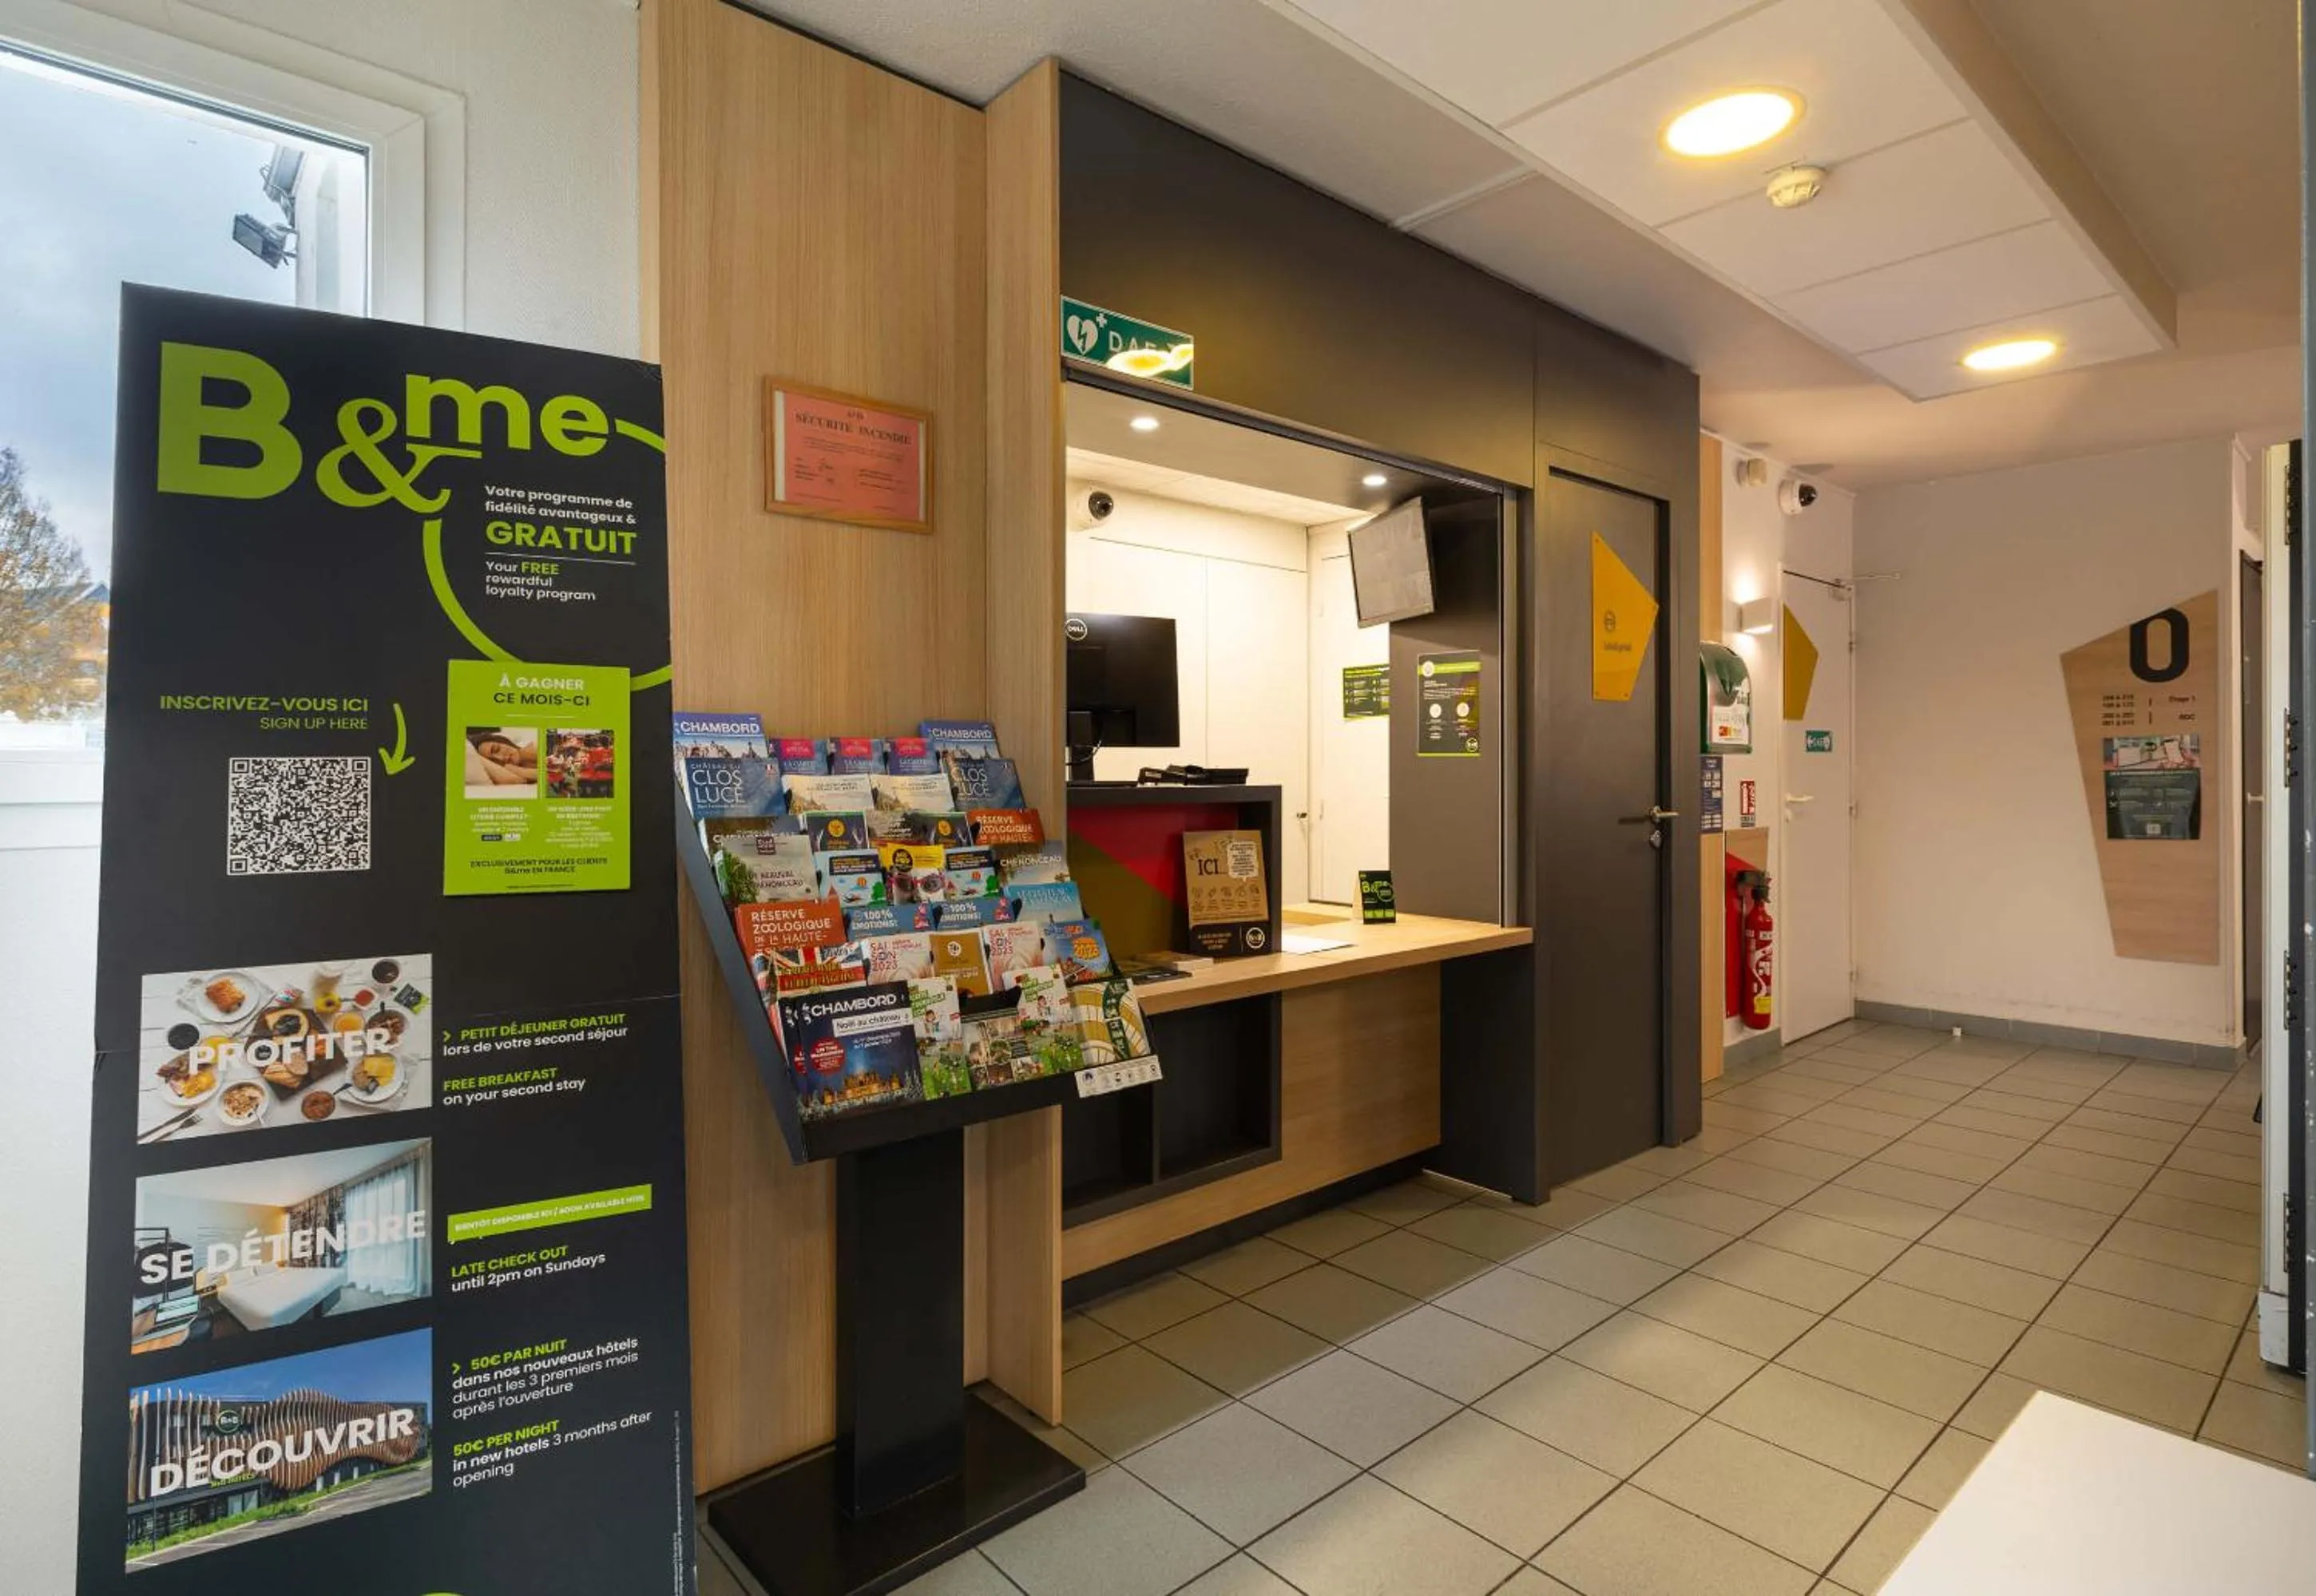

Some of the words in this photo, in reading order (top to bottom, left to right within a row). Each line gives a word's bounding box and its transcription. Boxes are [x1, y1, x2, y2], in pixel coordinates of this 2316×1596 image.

[859, 426, 912, 445] INCENDIE
[486, 485, 525, 498] Votre
[528, 490, 613, 505] programme
[615, 498, 633, 509] de
[486, 501, 536, 515] fidélité
[538, 506, 623, 525] avantageux
[626, 514, 637, 525] &
[486, 521, 637, 554] GRATUIT
[486, 561, 518, 572] Your
[521, 561, 560, 575] FREE
[486, 574, 553, 587] rewardful
[486, 584, 533, 599] loyalty
[537, 590, 596, 602] program
[499, 673, 511, 687] À
[515, 677, 585, 691] GAGNER
[160, 695, 338, 711] INSCRIVEZ-VOUS
[343, 698, 369, 712] ICI
[494, 692, 516, 704] CE
[520, 693, 590, 707] MOIS-CI
[260, 717, 299, 730] SIGN
[304, 718, 326, 730] UP
[330, 719, 368, 730] HERE
[680, 721, 761, 734] CHAMBORD
[932, 728, 992, 739] CHAMBORD
[692, 770, 742, 786] CLOS
[470, 859, 537, 869] EXCLUSIVEMENT
[752, 908, 805, 921] RÉSERVE
[753, 918, 831, 935] ZOOLOGIQUE
[990, 947, 1013, 956] 2023
[871, 961, 898, 972] 2023
[811, 994, 897, 1016] CHAMBORD
[461, 1027, 497, 1040] PETIT
[500, 1020, 568, 1036] DÉJEUNER
[569, 1013, 626, 1028] GRATUIT
[188, 1028, 391, 1075] PROFITER
[443, 1044, 470, 1056] lors
[474, 1041, 492, 1053] de
[495, 1037, 531, 1050] votre
[535, 1030, 585, 1046] second
[588, 1027, 629, 1042] séjour
[443, 1078, 476, 1091] FREE
[479, 1067, 558, 1088] BREAKFAST
[443, 1094, 462, 1106] on
[466, 1090, 499, 1106] your
[502, 1081, 553, 1099] second
[557, 1078, 586, 1092] stay
[141, 1248, 196, 1285] SE
[206, 1209, 426, 1273] DÉTENDRE
[451, 1261, 486, 1278] LATE
[487, 1253, 536, 1272] CHECK
[540, 1245, 569, 1261] OUT
[451, 1275, 485, 1293] until
[487, 1269, 521, 1289] 2pm
[524, 1266, 542, 1278] on
[545, 1253, 606, 1274] Sundays
[452, 1372, 491, 1390] dans
[494, 1364, 521, 1381] nos
[523, 1348, 594, 1372] nouveaux
[596, 1337, 639, 1356] hôtels
[471, 1354, 502, 1371] 50€
[503, 1347, 532, 1364] PAR
[534, 1339, 568, 1356] NUIT
[452, 1383, 502, 1405] durant
[506, 1377, 525, 1392] les
[529, 1374, 539, 1386] 3
[541, 1358, 603, 1387] premiers
[605, 1351, 639, 1368] mois
[452, 1399, 495, 1421] après
[498, 1382, 574, 1408] l'ouverture
[453, 1439, 485, 1457] 50€
[486, 1432, 514, 1449] PER
[515, 1419, 560, 1441] NIGHT
[453, 1459, 467, 1472] in
[470, 1450, 503, 1468] new
[505, 1438, 550, 1459] hotels
[553, 1433, 562, 1446] 3
[564, 1420, 618, 1444] months
[620, 1410, 652, 1429] after
[150, 1408, 414, 1497] DÉCOUVRIR
[453, 1462, 514, 1488] opening
